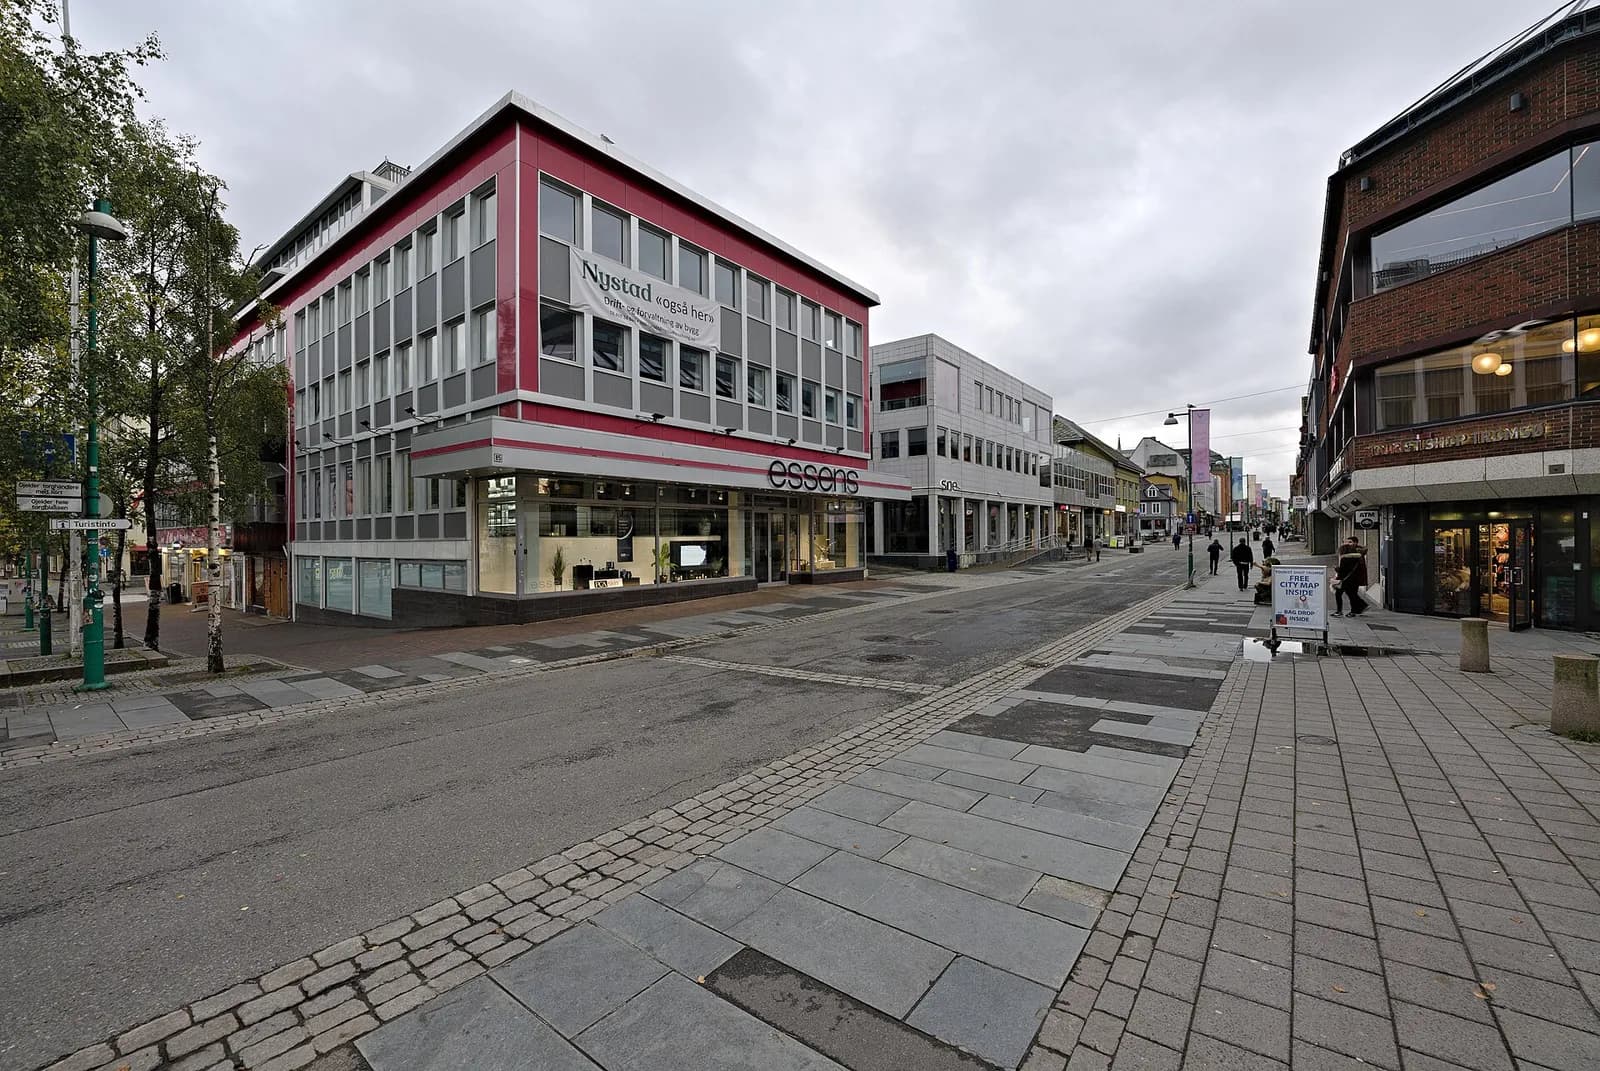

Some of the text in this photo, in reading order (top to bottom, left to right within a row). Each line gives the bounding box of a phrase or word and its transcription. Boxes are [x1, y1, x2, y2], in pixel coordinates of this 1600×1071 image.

[582, 259, 715, 323] Nystad «også her»
[604, 296, 625, 310] Drift-
[636, 307, 674, 328] forvaltning
[673, 321, 683, 329] av
[684, 322, 700, 337] bygg
[767, 460, 859, 494] essens
[73, 520, 117, 528] Turistinfo
